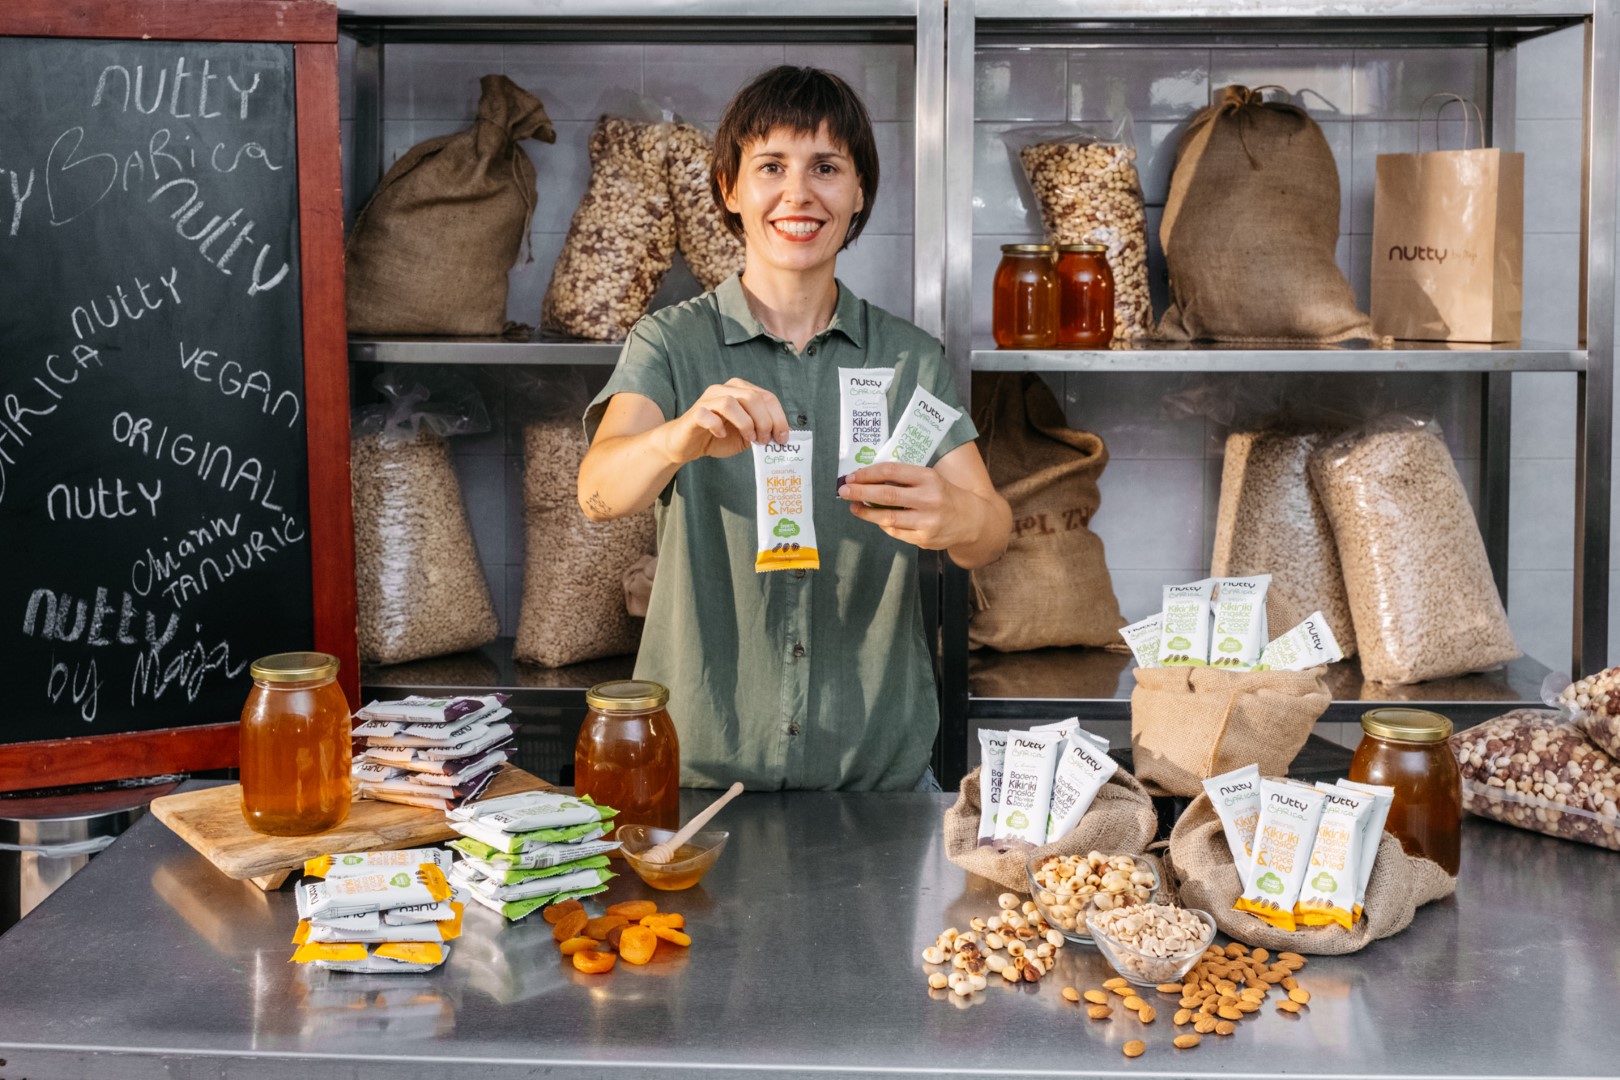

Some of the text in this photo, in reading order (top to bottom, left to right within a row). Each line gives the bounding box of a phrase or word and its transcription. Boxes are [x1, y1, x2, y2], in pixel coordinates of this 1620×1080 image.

[1389, 246, 1447, 264] nutty
[850, 378, 882, 388] nutty
[918, 400, 945, 424] nutty
[852, 418, 880, 426] Kikiriki
[764, 444, 801, 454] nutty
[766, 476, 802, 487] Kikiriki
[768, 500, 802, 515] & Med
[1305, 621, 1324, 651] nutty
[48, 652, 104, 722] by
[1014, 739, 1046, 750] nutty
[1074, 747, 1102, 772] nutty
[1010, 771, 1038, 782] Badem
[1008, 780, 1037, 792] Kikiriki
[1220, 782, 1252, 796] nutty
[1270, 793, 1308, 812] nutty
[1325, 794, 1360, 809] nutty
[1264, 825, 1300, 844] Kikiriki
[1268, 860, 1293, 874] Med
